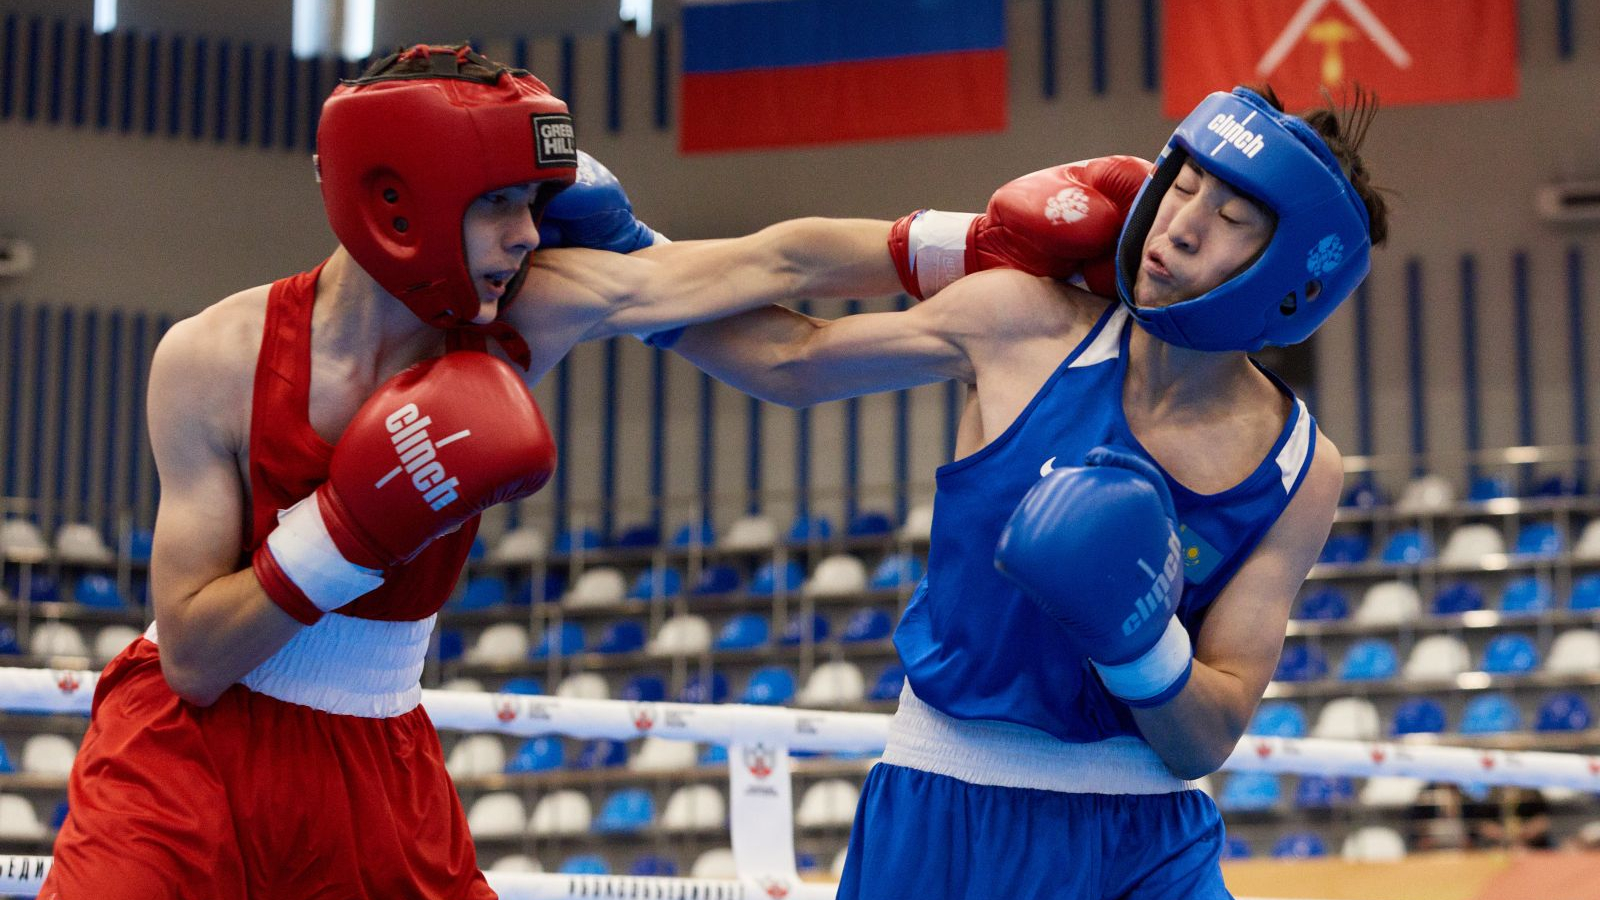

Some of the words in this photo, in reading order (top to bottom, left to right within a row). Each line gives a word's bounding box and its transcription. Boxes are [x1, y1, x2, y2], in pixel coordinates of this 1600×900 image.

[540, 123, 575, 139] GREE
[543, 137, 575, 155] HILL
[1207, 113, 1264, 159] clinch
[385, 403, 460, 511] clinch
[1122, 530, 1182, 637] clinch
